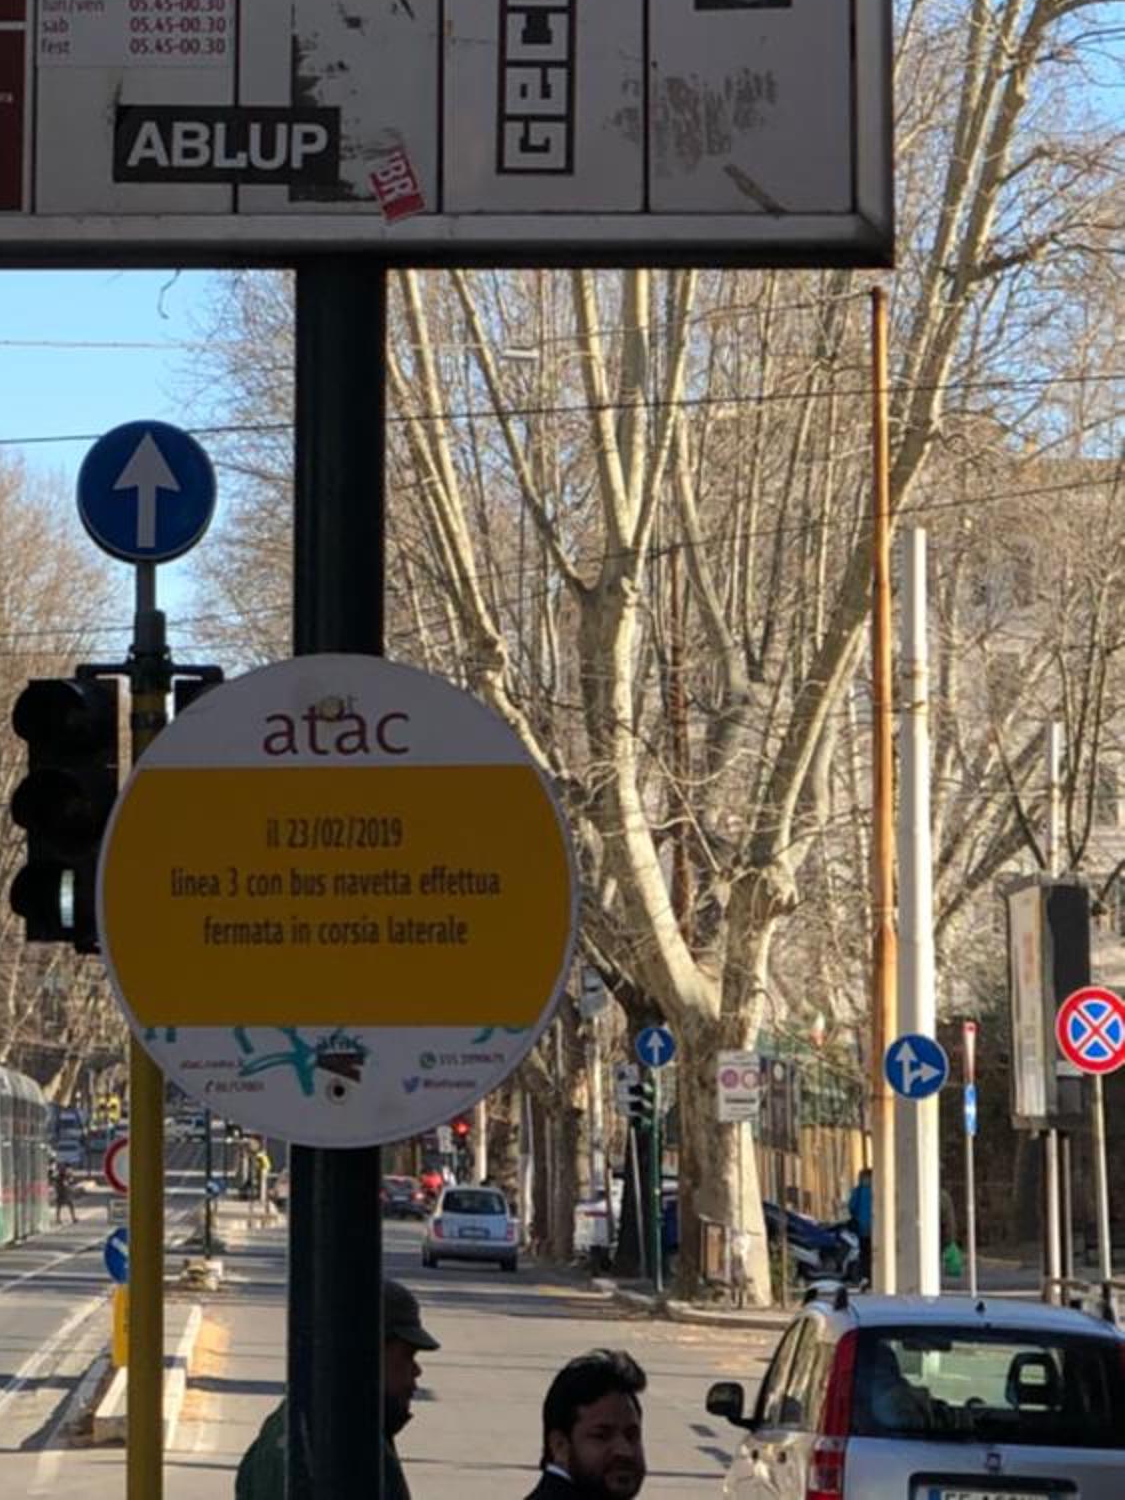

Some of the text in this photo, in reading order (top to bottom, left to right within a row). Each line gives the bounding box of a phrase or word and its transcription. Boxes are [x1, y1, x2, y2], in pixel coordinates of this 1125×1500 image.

[43, 18, 69, 33] sab
[42, 39, 70, 53] fest
[126, 121, 329, 170] ABLUP
[263, 706, 410, 756] atac
[267, 817, 402, 849] il 23/02/2019
[170, 866, 500, 897] linea 3 con bus navetta effettua
[203, 914, 468, 945] fermata in corsia laterale
